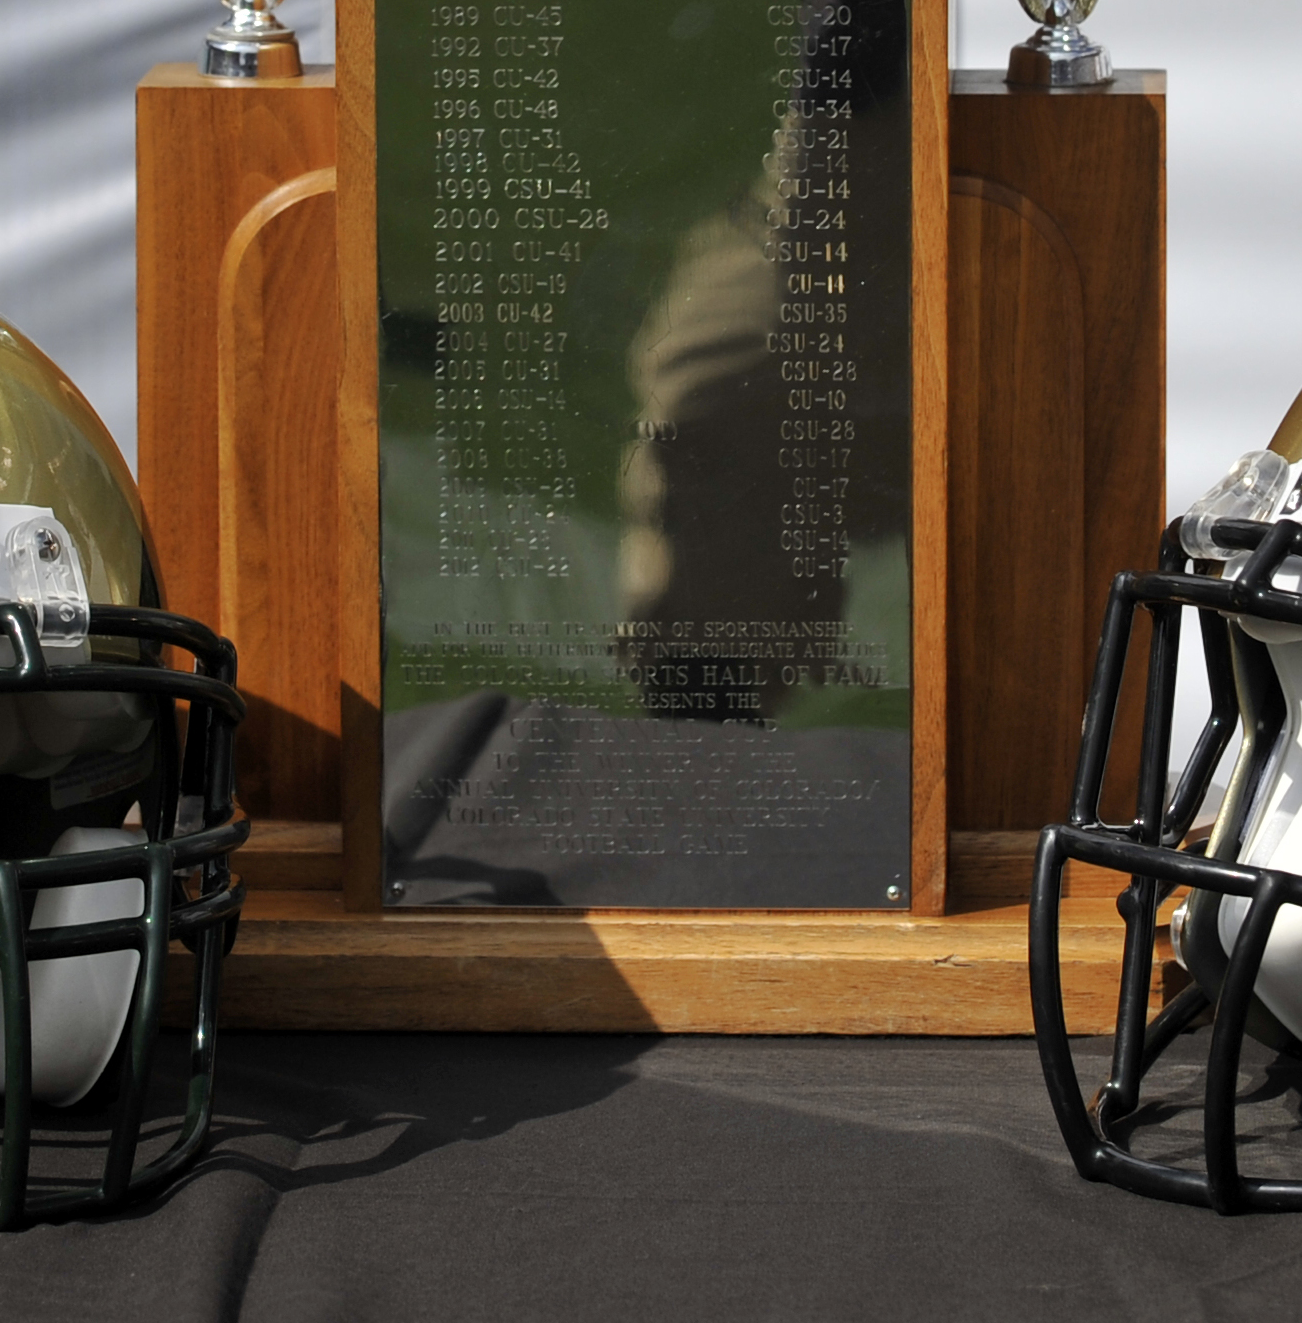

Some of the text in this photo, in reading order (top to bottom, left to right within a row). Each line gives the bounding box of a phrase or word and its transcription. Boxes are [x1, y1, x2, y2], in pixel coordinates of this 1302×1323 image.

[430, 4, 853, 27] 1989 CU-45 CSU-20
[430, 35, 853, 58] 1992 CU-37 CSU-17
[432, 67, 853, 89] 1995 CU-42 CSU-14
[432, 98, 853, 120] 1996 CU-48 CSU-34
[435, 127, 850, 150] 1997 CU-31 CSU-21
[434, 151, 850, 174] 1998 CU-42 CSU-14
[435, 177, 852, 200] 1999 CSU-41 CU-14
[432, 207, 847, 230] 2000 CSU-28 CU-24
[434, 240, 849, 263] 2001 CU-41 CSU-14
[434, 272, 846, 295] 2002 CSU-19 CU-14
[437, 301, 848, 324] 2003 CU-42 CSU-35
[434, 330, 845, 354] 2004 CU-27 CSU-24
[434, 359, 858, 382] 2005 CU-31 CSU-28
[498, 388, 567, 411] CSU-14
[787, 388, 847, 411] CU-10
[434, 419, 487, 442] 2007
[501, 419, 559, 442] CU-31
[779, 419, 856, 441] CSU-28
[436, 447, 852, 470] 2008 CU-38 CSU-17
[792, 476, 850, 499] CU-17
[780, 503, 845, 526] CSU-3
[779, 529, 850, 552] CSU-14
[438, 555, 481, 578] 2012
[792, 556, 850, 578] CU-17
[432, 620, 453, 639] IN
[462, 620, 497, 639] THE
[670, 620, 696, 639] OF
[703, 620, 854, 639] SPORTSMANSHIP
[441, 641, 471, 659] FOR
[478, 641, 509, 659] THE
[627, 641, 646, 659] OF
[653, 641, 796, 659] INTERCOLLEGIATE
[802, 641, 890, 659] ATHLETICS
[399, 664, 891, 687] THE COLORADO SPORTS HALL OF FAME
[623, 691, 717, 709] PRESENTS
[724, 691, 762, 709] THE
[694, 778, 722, 801] OF
[444, 805, 575, 827] COLORADO
[587, 805, 665, 827] STATE
[540, 832, 666, 855] FOOTBALL
